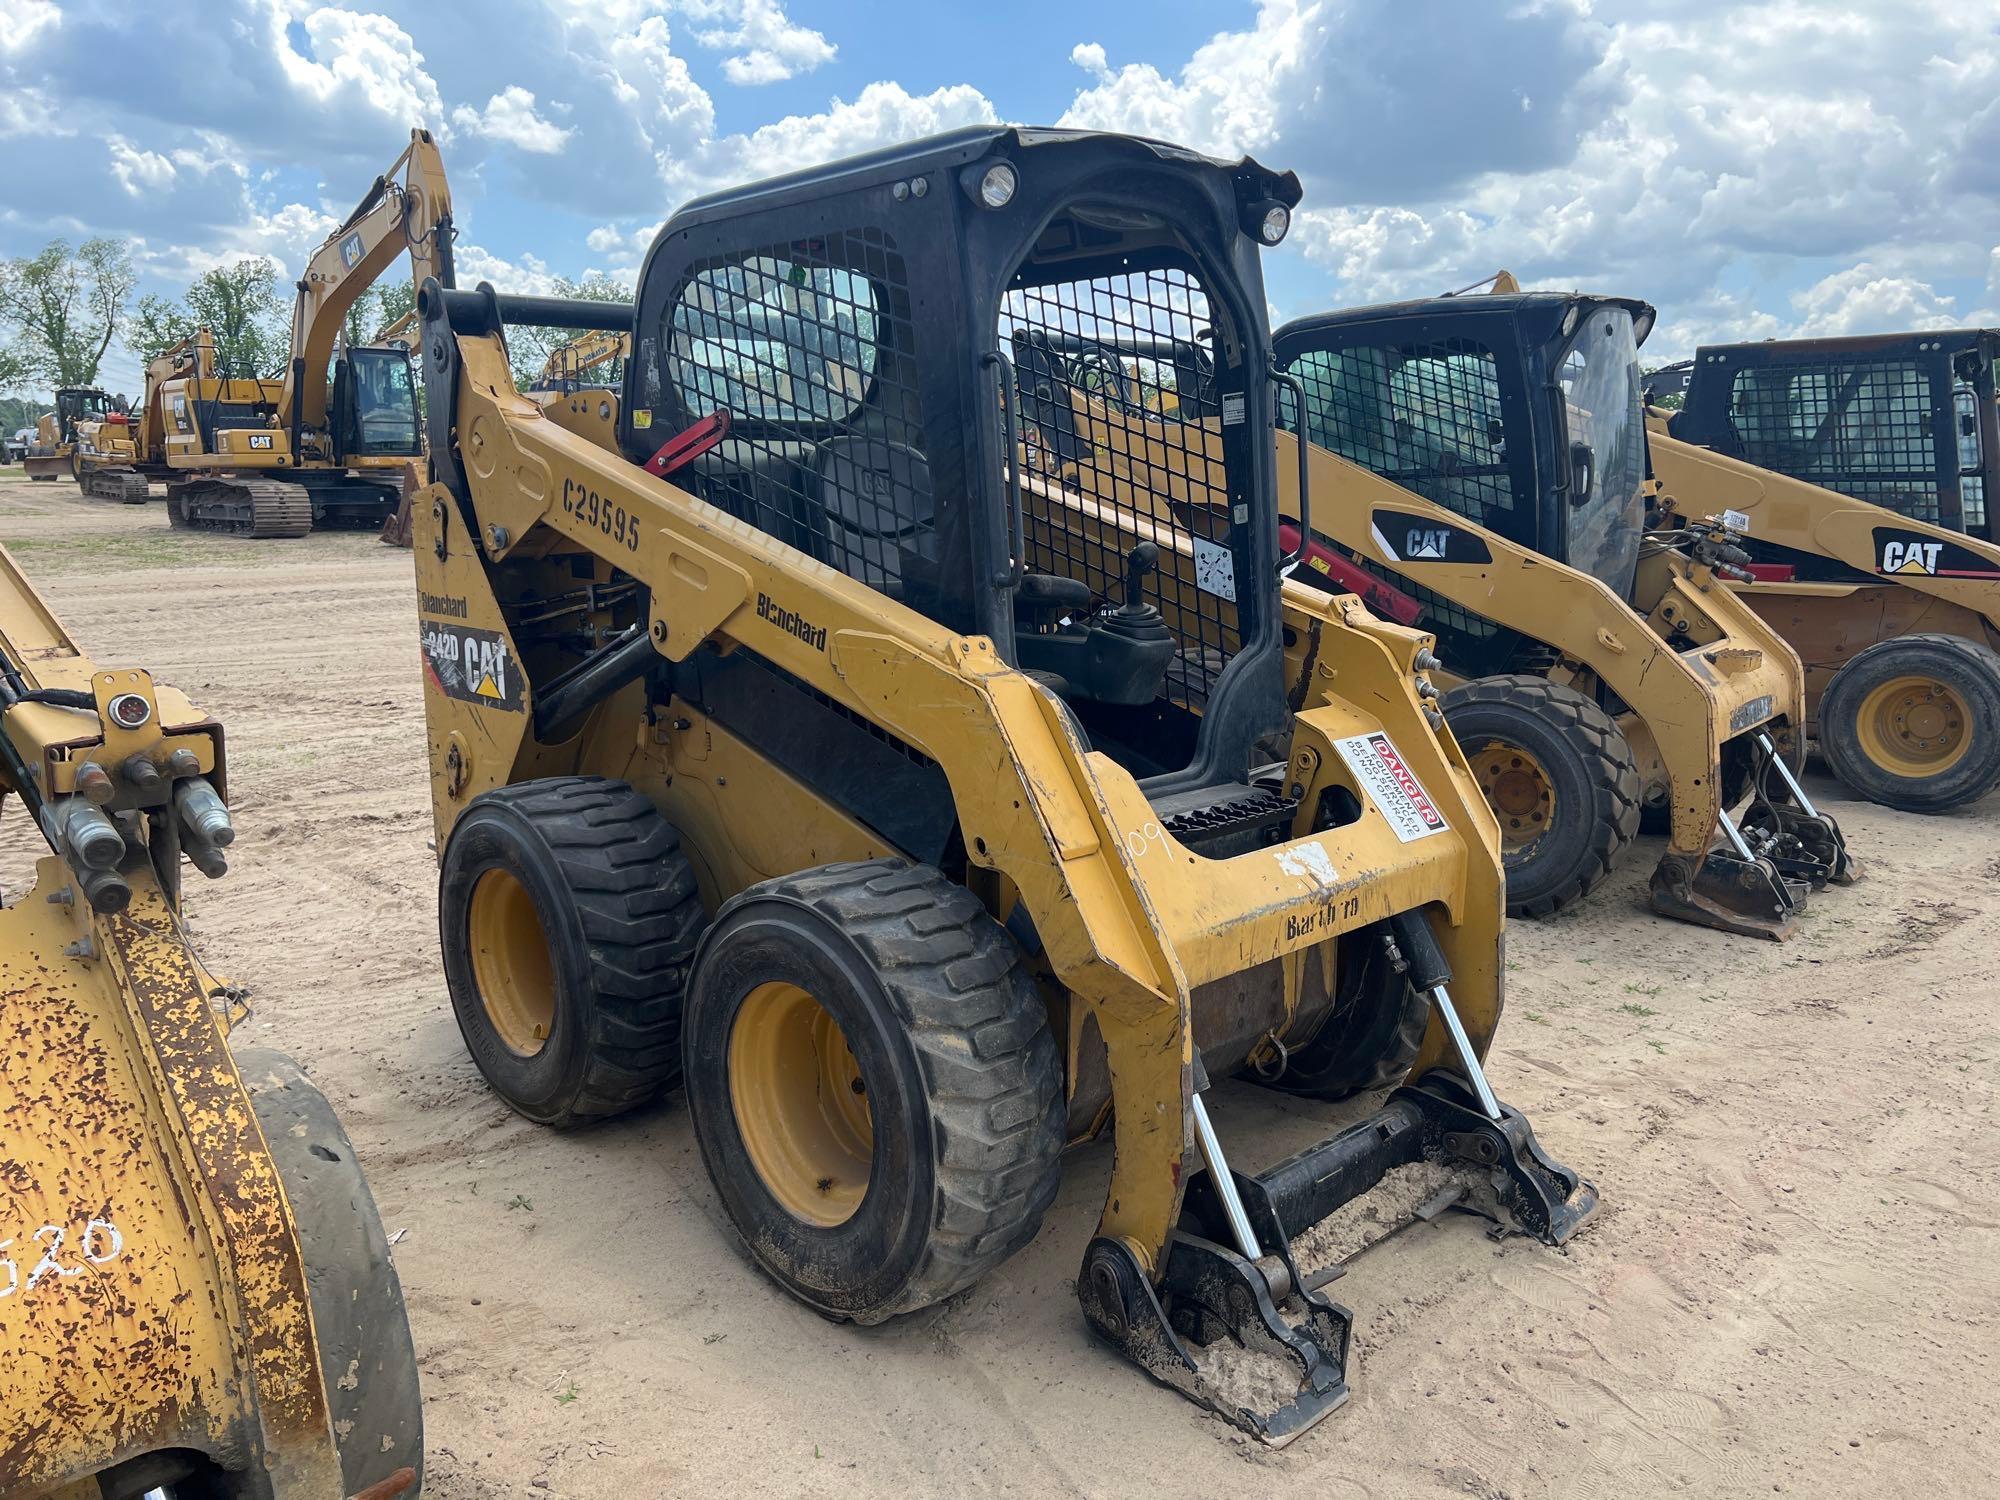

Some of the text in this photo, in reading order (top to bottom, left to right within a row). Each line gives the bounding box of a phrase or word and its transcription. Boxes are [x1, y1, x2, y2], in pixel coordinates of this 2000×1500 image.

[250, 436, 271, 448] CAT
[563, 478, 640, 552] C29595
[1406, 528, 1451, 557] CAT
[1883, 541, 1943, 574] CAT
[421, 591, 467, 618] Blanchard
[757, 591, 827, 652] Blanchard
[428, 631, 507, 700] 242D CAT
[1346, 740, 1415, 837] DO NOT OPERATE
[1354, 741, 1421, 834] BEING SERVICED
[1370, 752, 1418, 815] EQUIPMENT
[1375, 740, 1439, 825] DANGER
